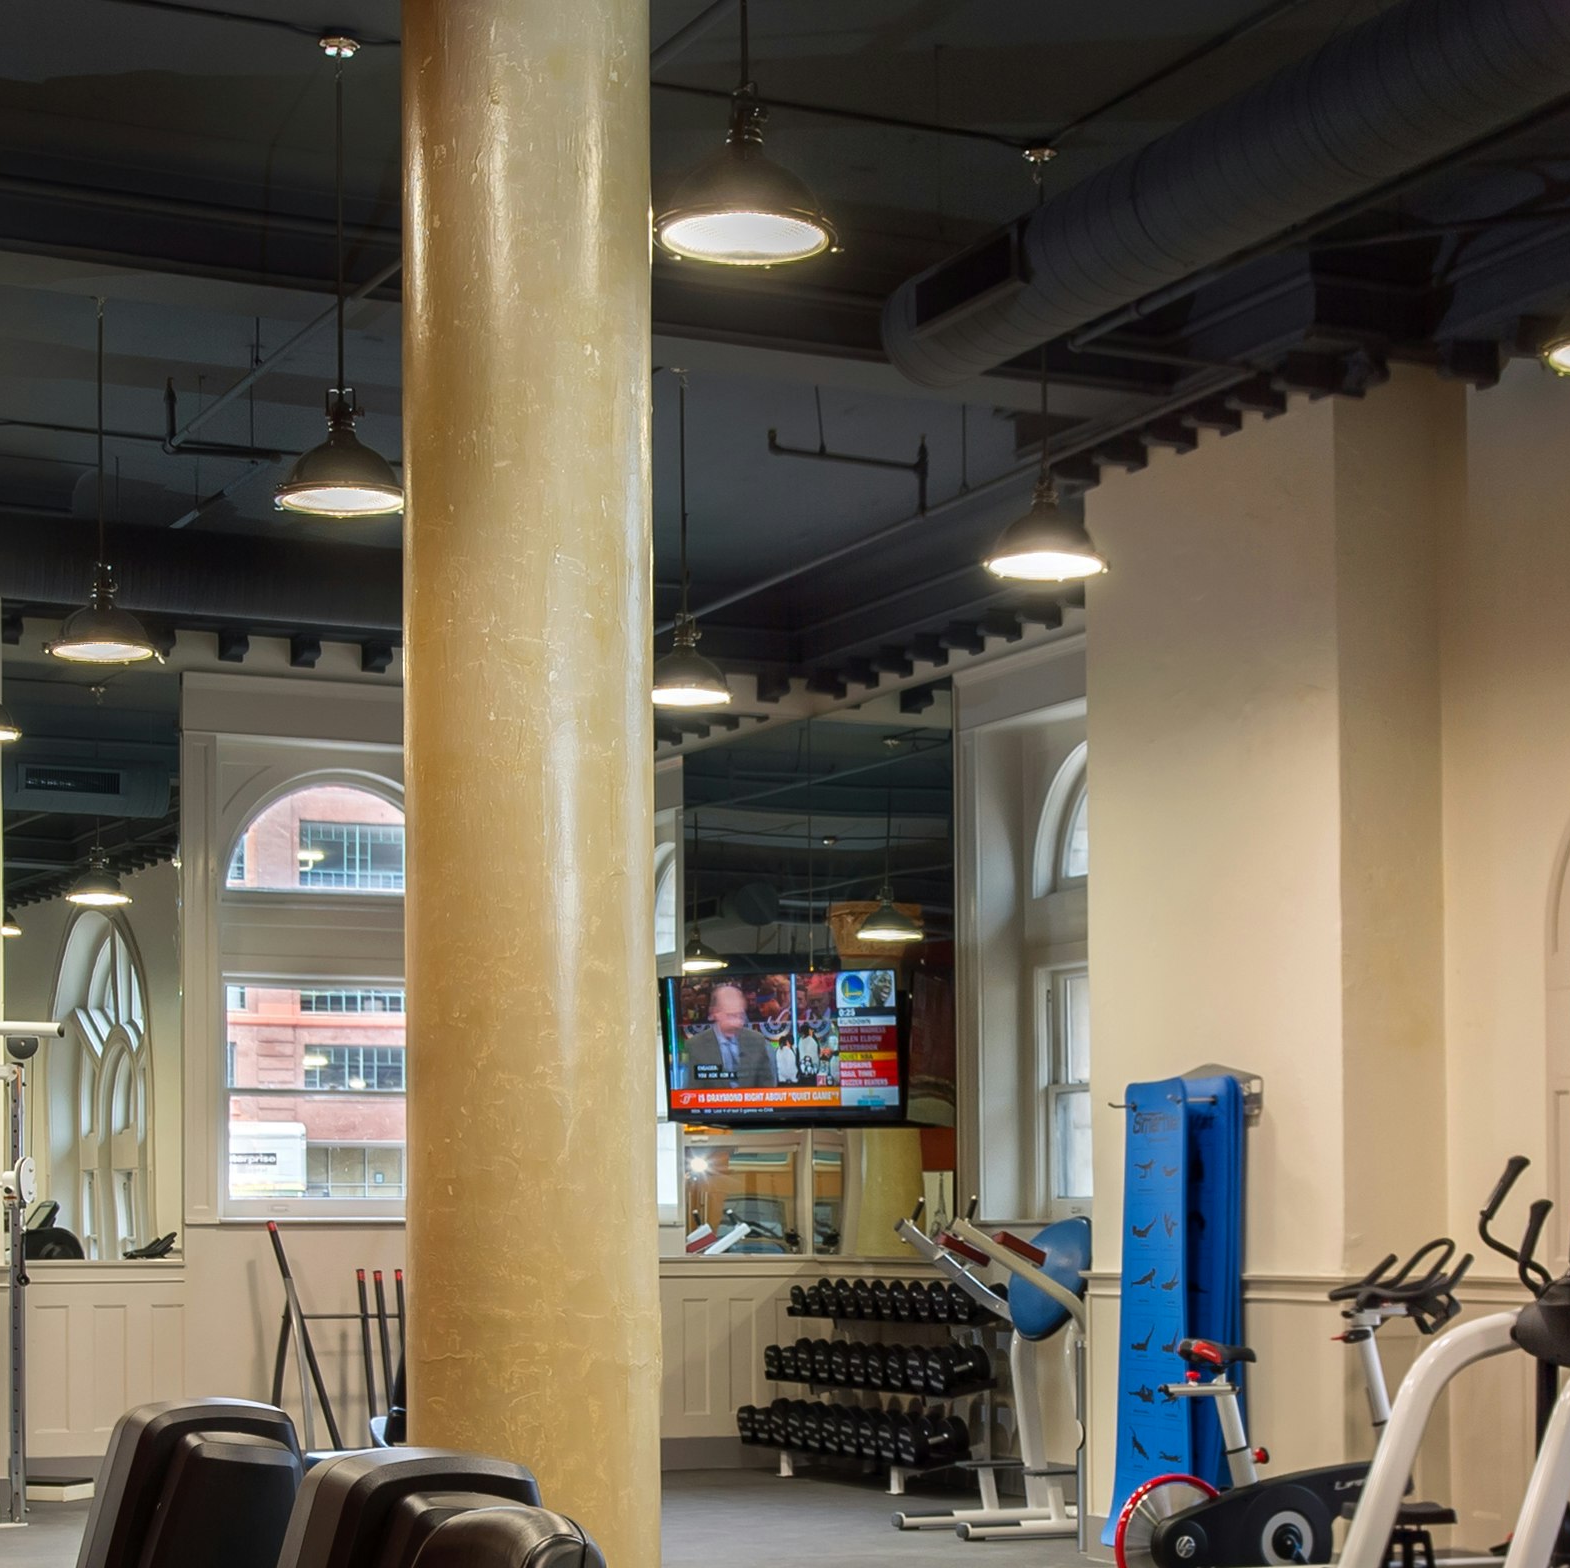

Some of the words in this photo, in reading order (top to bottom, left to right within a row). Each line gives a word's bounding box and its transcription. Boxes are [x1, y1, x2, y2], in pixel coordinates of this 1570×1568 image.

[706, 1093, 743, 1102] DRAYMOND
[744, 1093, 764, 1101] RIGHT
[765, 1092, 787, 1101] ABOUT
